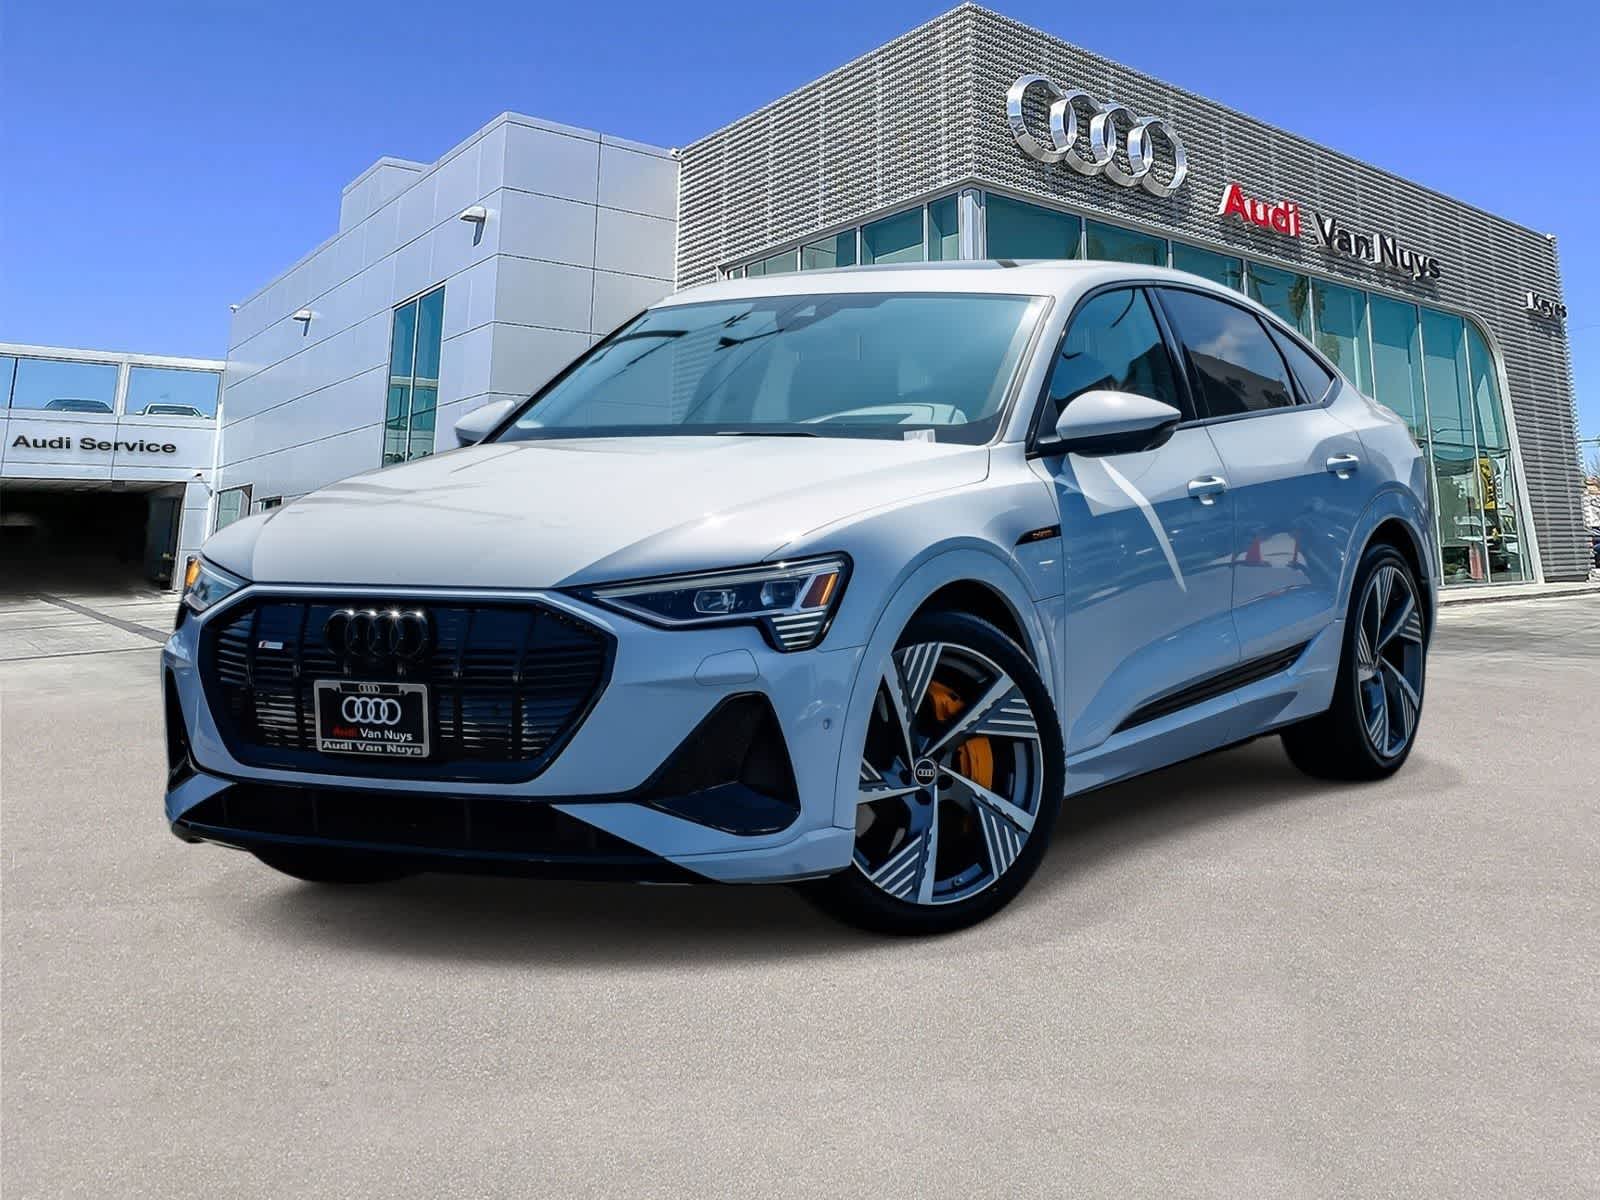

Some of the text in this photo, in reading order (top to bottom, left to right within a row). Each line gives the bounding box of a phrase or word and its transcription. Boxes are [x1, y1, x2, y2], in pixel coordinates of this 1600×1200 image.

[1217, 182, 1441, 281] Audi Van Nuys
[1526, 291, 1567, 318] Keyes
[12, 435, 177, 454] Audi Service
[360, 728, 381, 739] Van
[384, 730, 413, 743] Nuys
[323, 741, 421, 756] Audi Van Nuys
